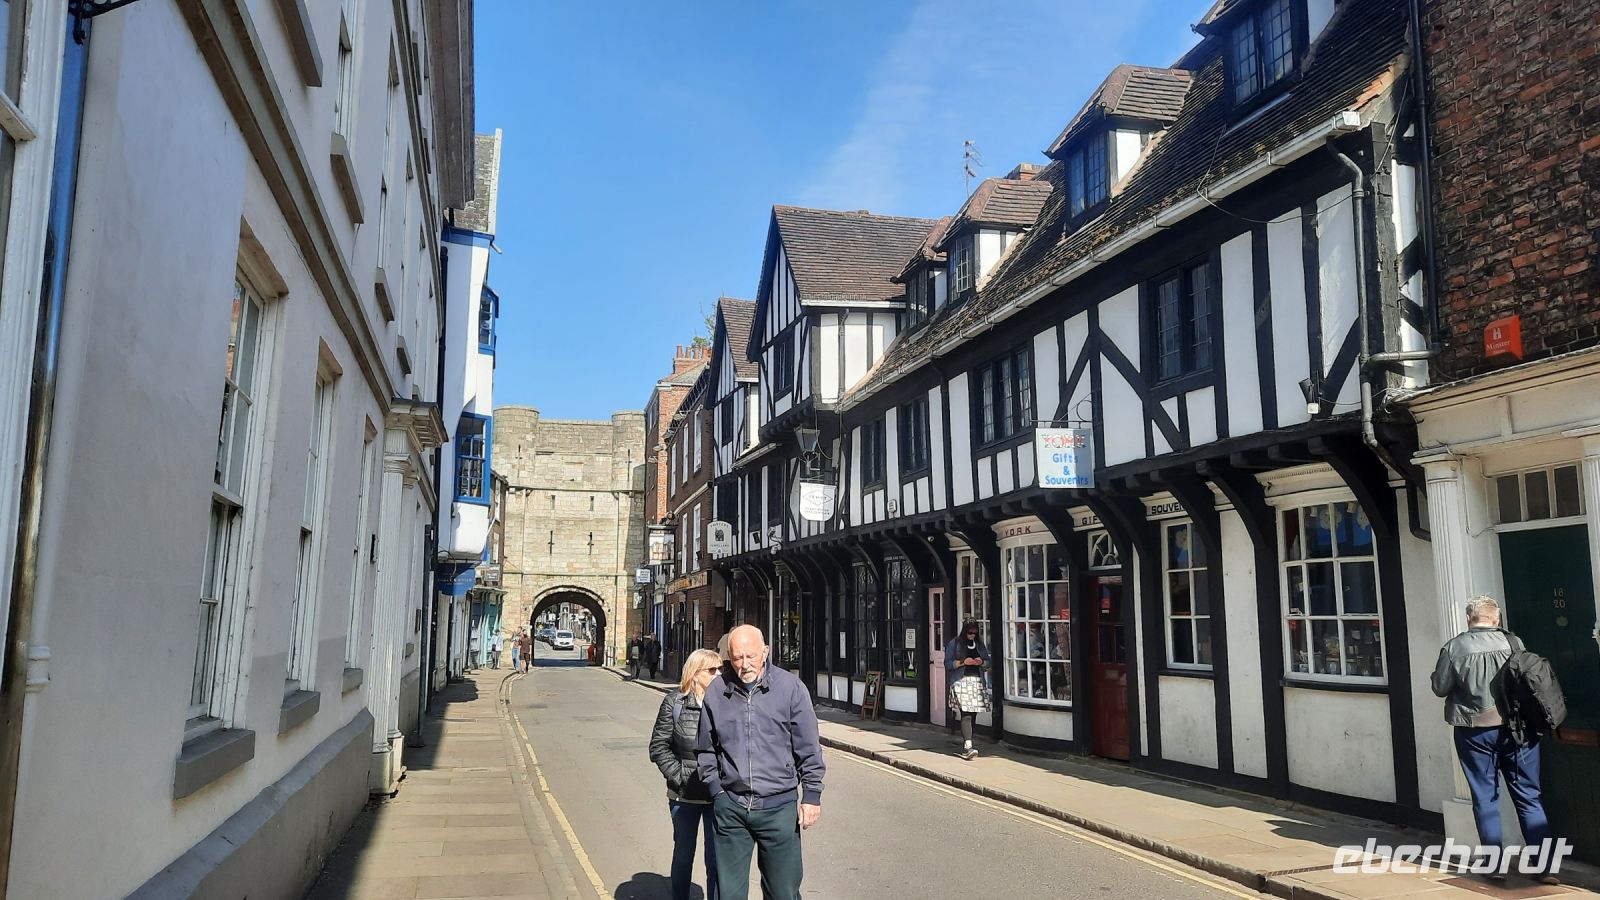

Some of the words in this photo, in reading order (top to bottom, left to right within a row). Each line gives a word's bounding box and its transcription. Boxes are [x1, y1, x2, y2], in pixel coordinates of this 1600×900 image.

[1063, 465, 1070, 476] &
[1045, 475, 1089, 485] Souvenirs
[1005, 526, 1032, 537] YORK
[1553, 599, 1566, 608] 20
